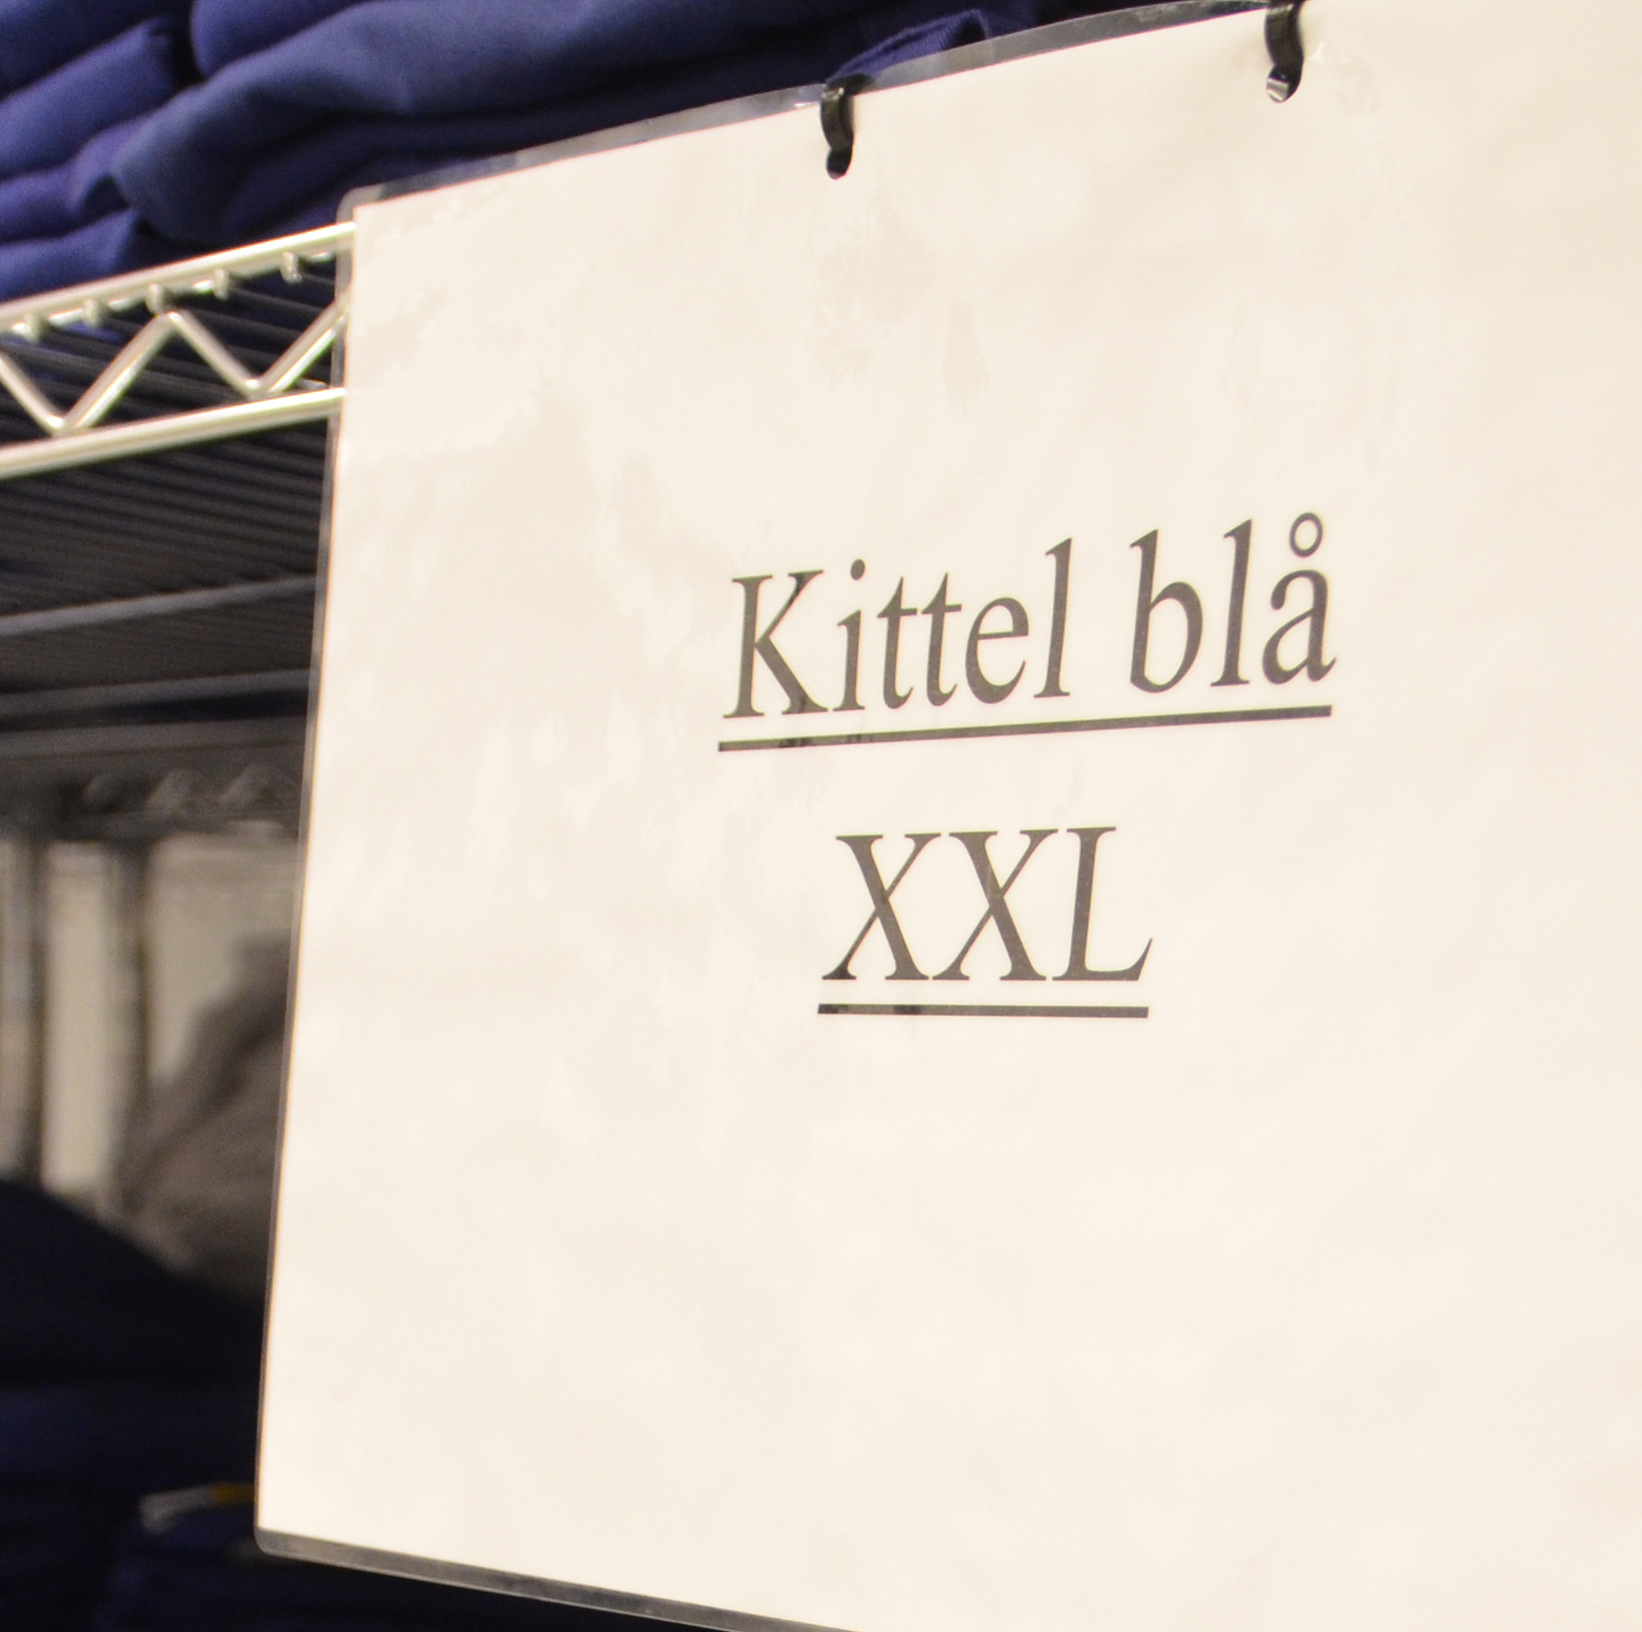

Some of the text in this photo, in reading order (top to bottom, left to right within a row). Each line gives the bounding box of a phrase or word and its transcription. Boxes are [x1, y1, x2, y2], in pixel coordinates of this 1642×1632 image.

[722, 510, 1338, 720] Kittel blå
[821, 825, 1154, 984] XXL
